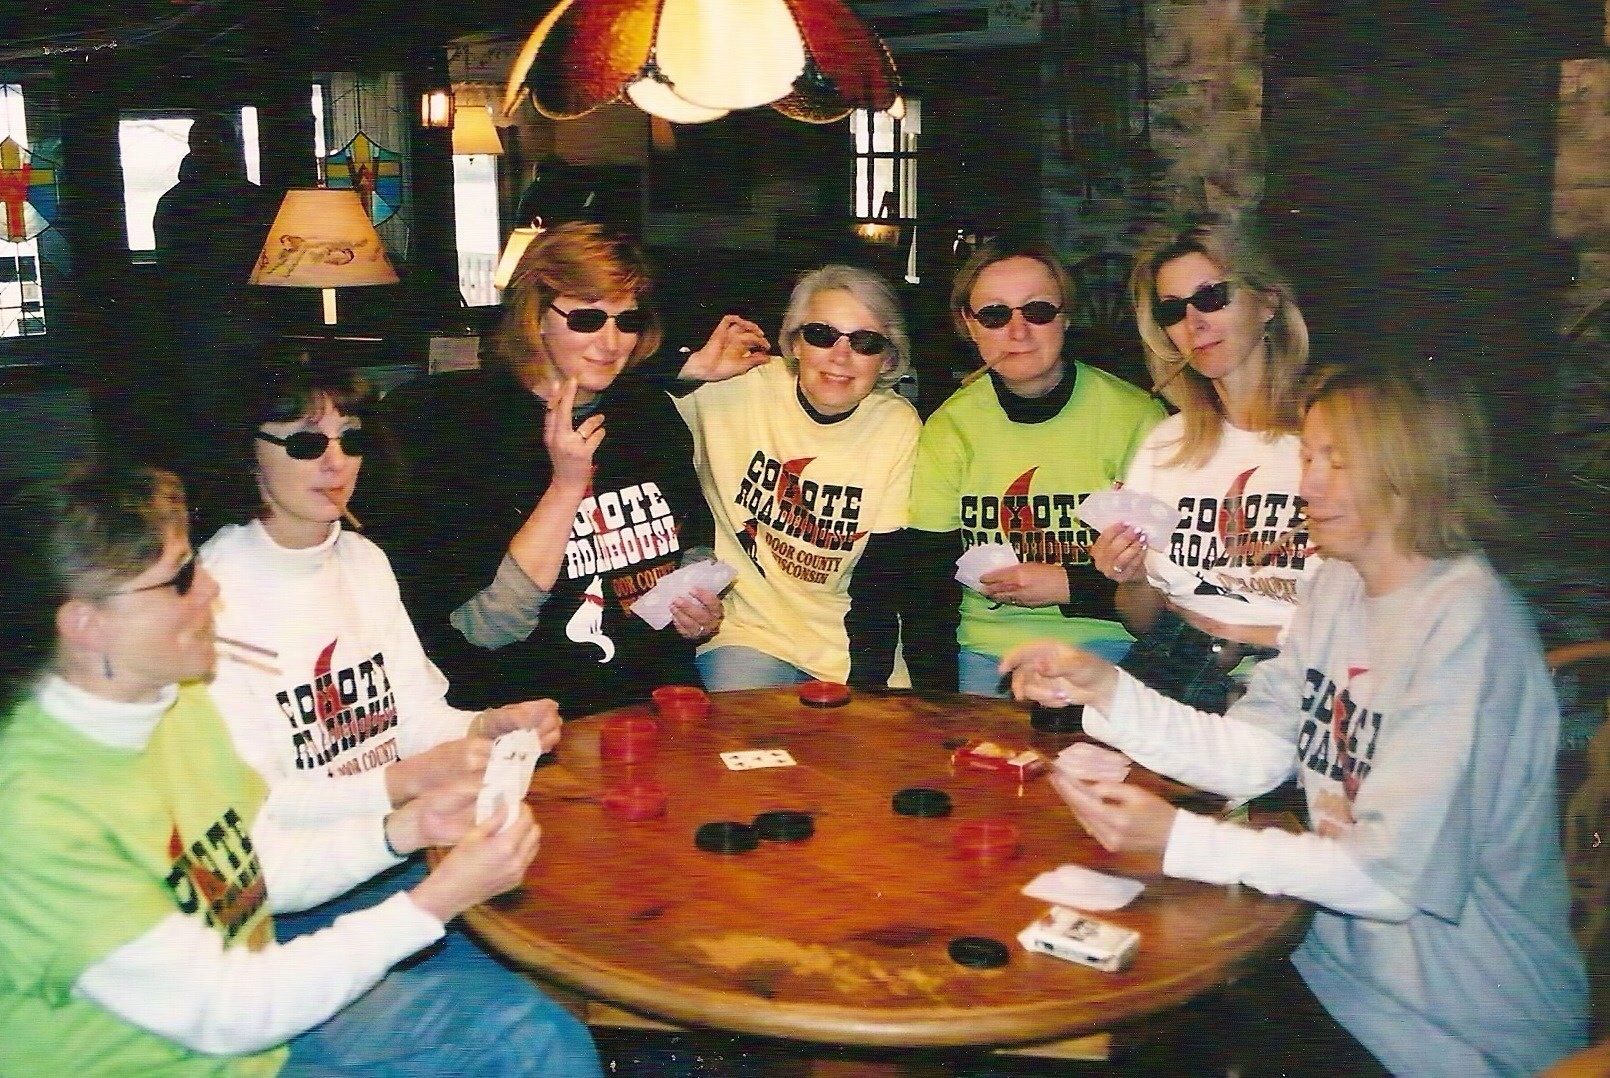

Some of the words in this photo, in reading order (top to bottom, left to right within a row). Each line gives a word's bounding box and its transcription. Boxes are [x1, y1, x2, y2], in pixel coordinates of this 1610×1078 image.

[570, 481, 671, 538] OYOTE
[734, 477, 858, 551] ROADHOUSE
[746, 450, 863, 520] COYOTE
[765, 531, 796, 560] DOOR
[797, 550, 843, 573] COUNTY
